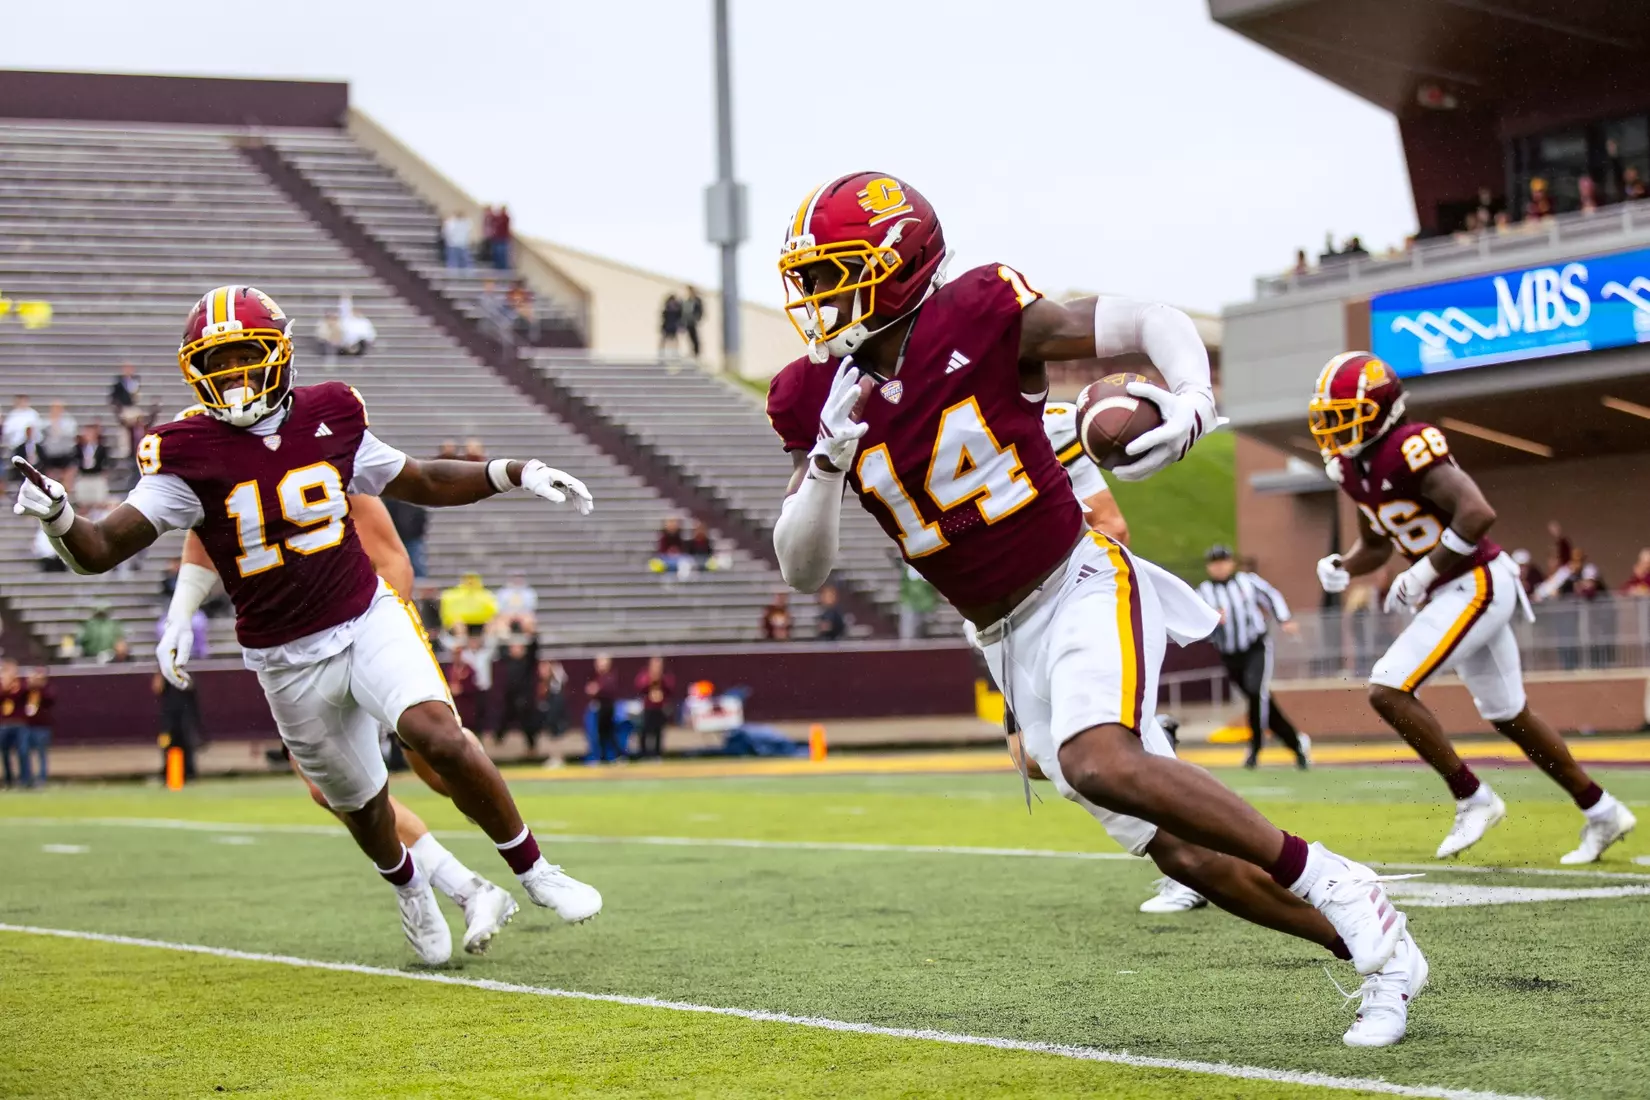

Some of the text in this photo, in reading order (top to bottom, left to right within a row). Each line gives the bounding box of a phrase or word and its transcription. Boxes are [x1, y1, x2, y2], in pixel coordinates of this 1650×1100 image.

[997, 265, 1046, 310] 1
[1493, 262, 1591, 338] MBS
[136, 433, 162, 476] 9
[856, 394, 1039, 560] 14
[1401, 426, 1449, 472] 26
[224, 460, 349, 578] 19
